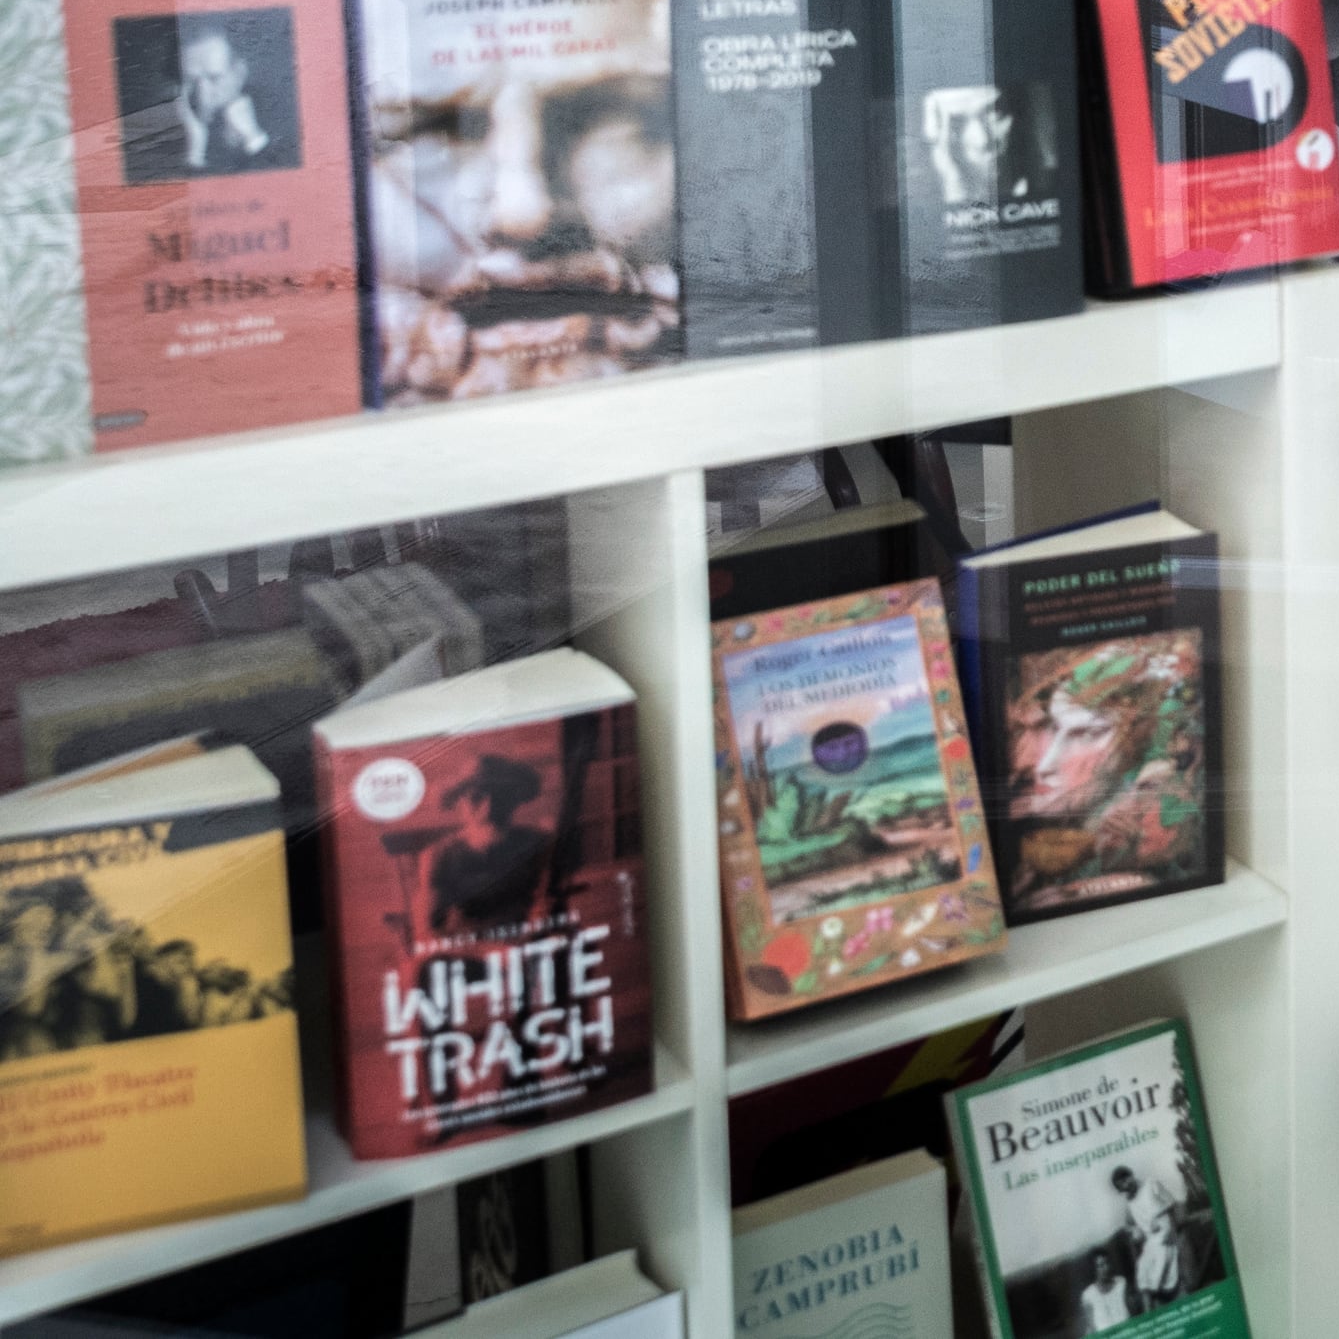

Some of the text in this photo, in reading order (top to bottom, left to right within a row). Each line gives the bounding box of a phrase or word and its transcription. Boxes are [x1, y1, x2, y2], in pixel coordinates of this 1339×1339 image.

[702, 0, 797, 21] LETRAS
[703, 34, 777, 56] OBRA
[705, 51, 836, 74] COMPLETA
[946, 198, 1061, 228] NICK CAVE
[148, 219, 290, 267] Miguel
[1024, 573, 1081, 597] PODER
[1088, 569, 1118, 589] DEL
[753, 648, 812, 676] Roger
[798, 657, 893, 691] DEMONIOS
[383, 923, 612, 1036] WHITE
[386, 994, 614, 1101] TRASH
[987, 1077, 1161, 1164] Beauvoir
[1021, 1074, 1120, 1121] Simone de
[1005, 1126, 1161, 1191] Las inseparables
[753, 1223, 905, 1295] ZENOBIA
[739, 1242, 921, 1332] CAMPRUBÍ
